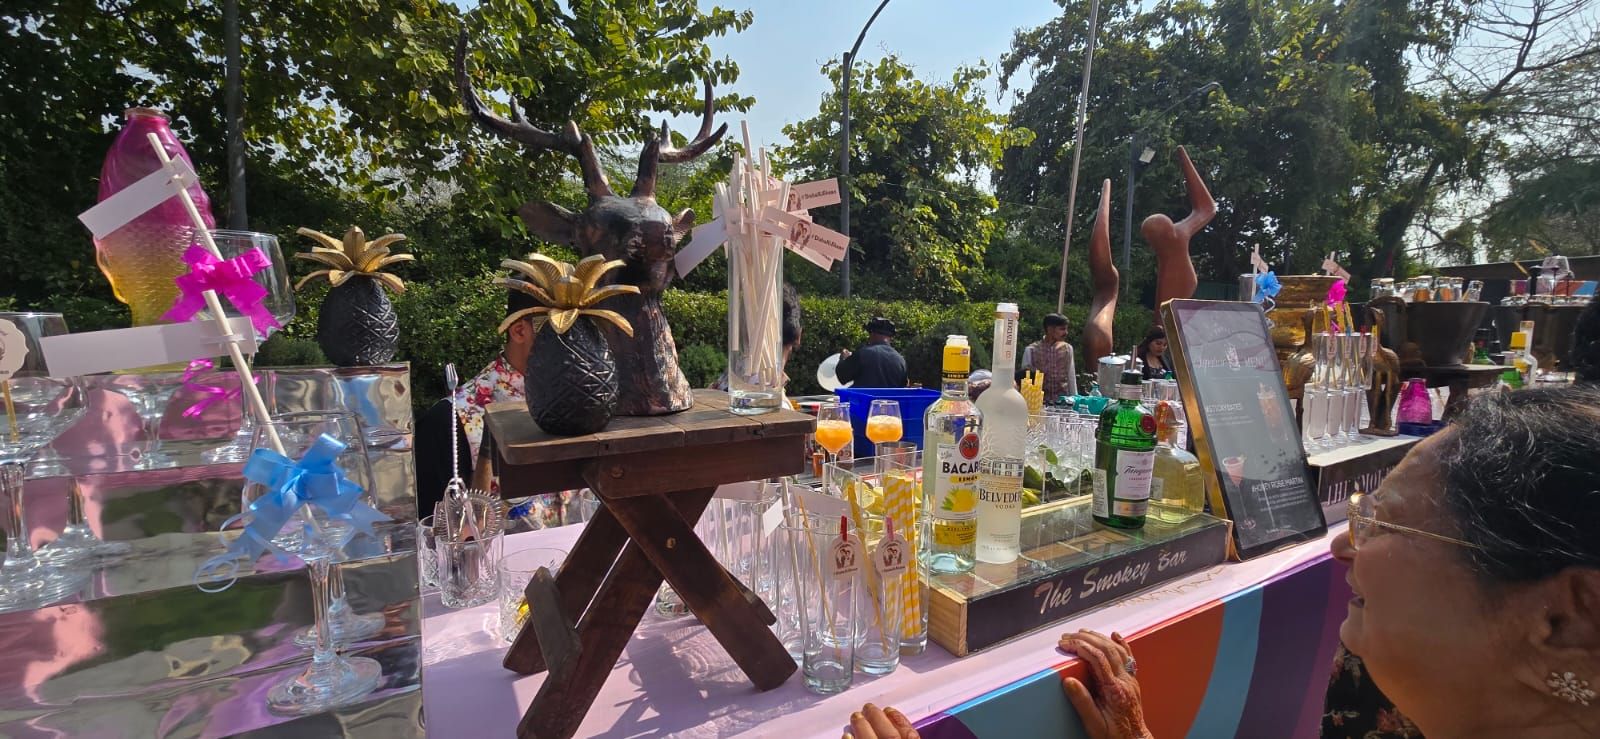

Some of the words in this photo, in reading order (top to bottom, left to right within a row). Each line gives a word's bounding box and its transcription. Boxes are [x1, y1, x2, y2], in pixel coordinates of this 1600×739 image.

[1034, 581, 1073, 615] The
[1080, 562, 1151, 600] Smokey
[1157, 549, 1188, 572] Bar
